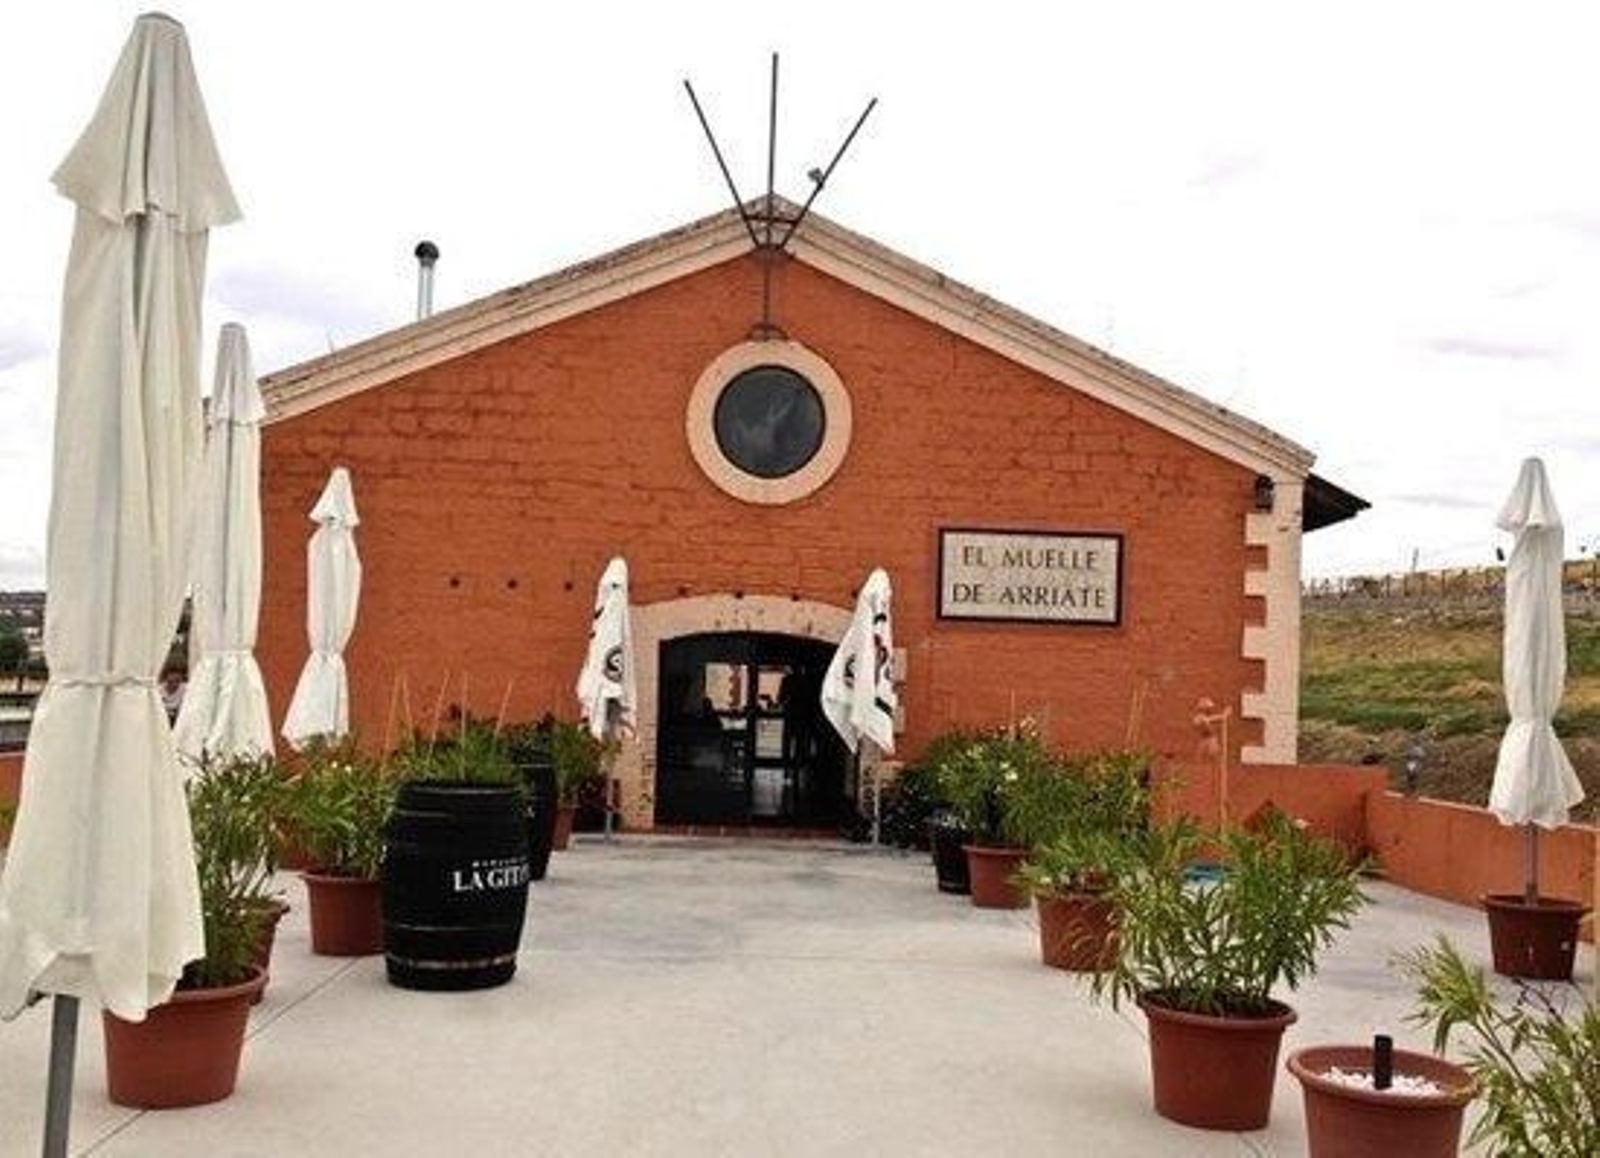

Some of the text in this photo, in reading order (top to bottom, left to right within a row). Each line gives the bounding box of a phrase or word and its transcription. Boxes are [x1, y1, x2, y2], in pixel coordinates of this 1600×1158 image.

[963, 545, 1099, 571] EL MUELLE
[952, 583, 1106, 609] DE ARRIATE
